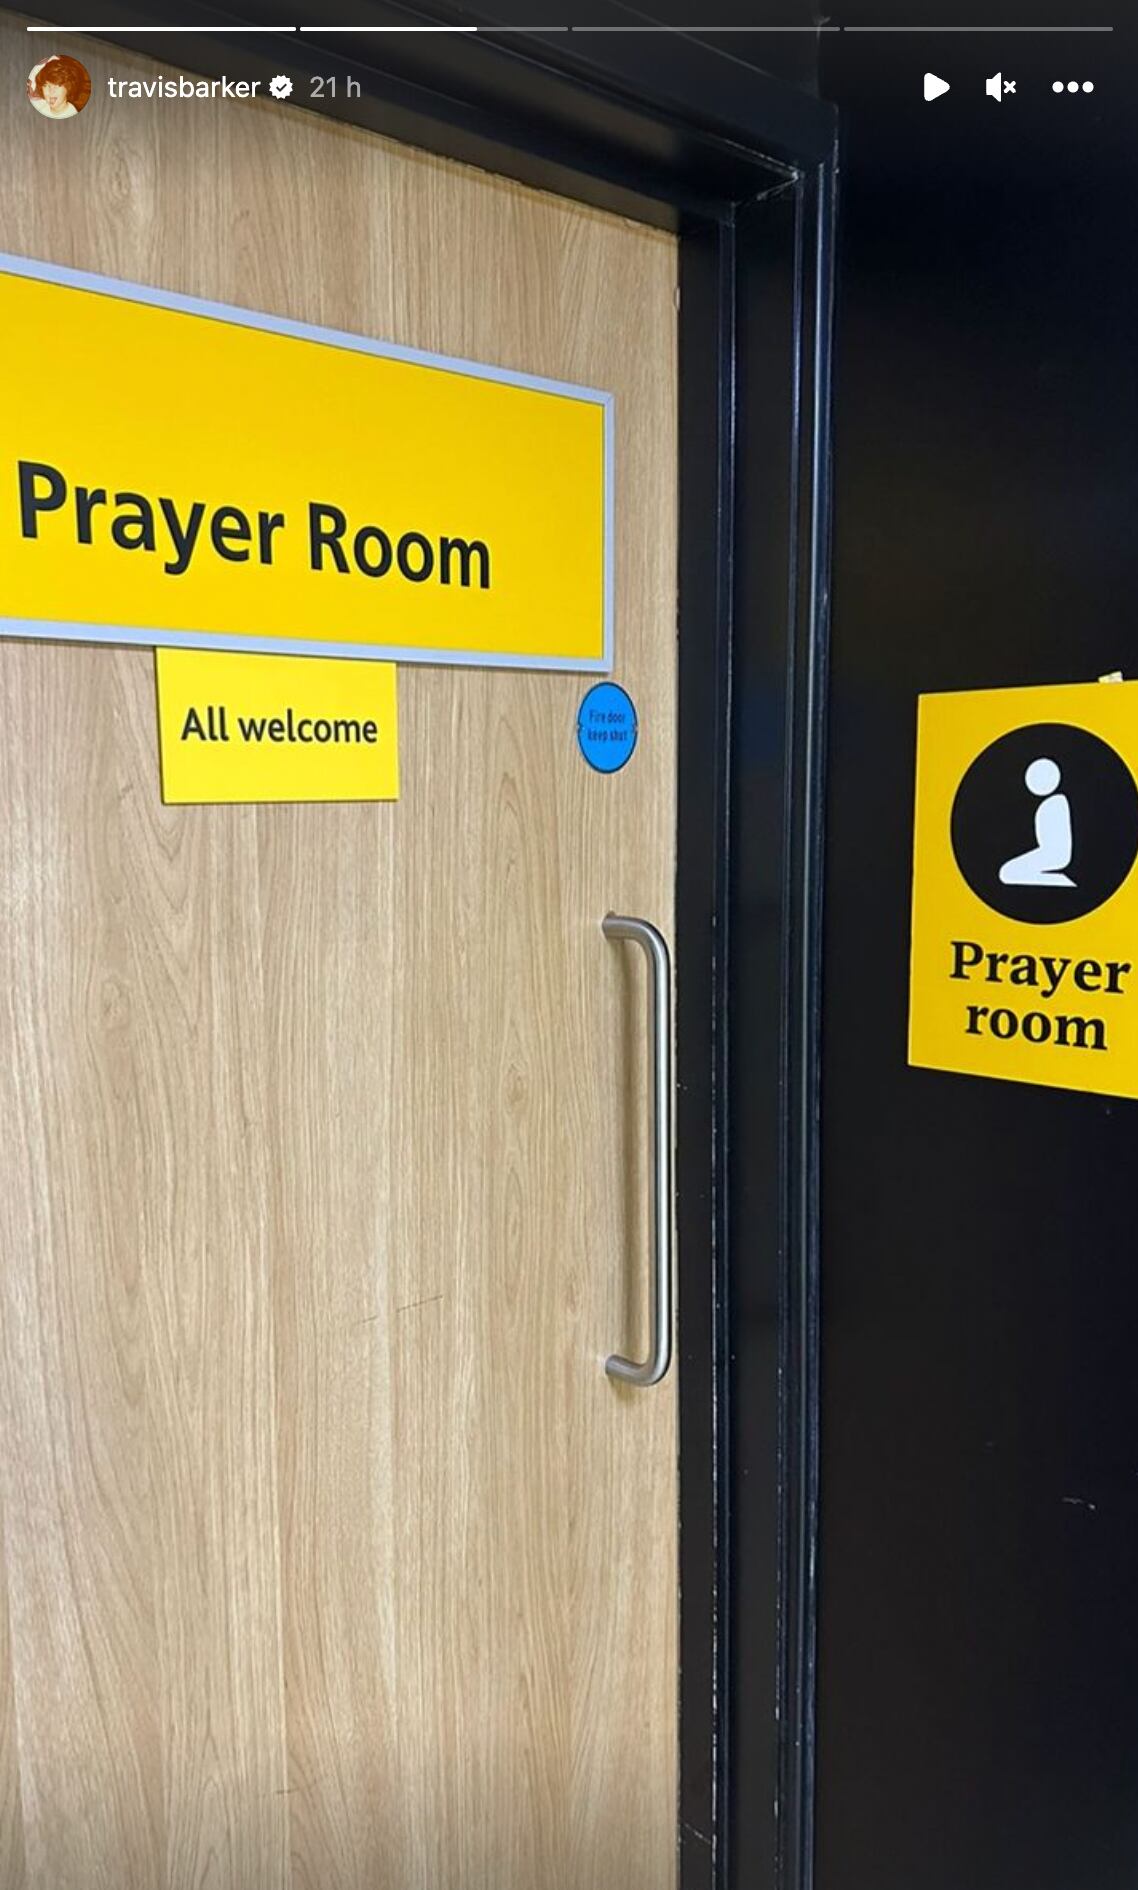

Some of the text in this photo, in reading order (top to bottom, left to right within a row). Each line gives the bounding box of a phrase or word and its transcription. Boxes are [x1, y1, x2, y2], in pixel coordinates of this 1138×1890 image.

[17, 460, 491, 590] Prayer Room
[180, 706, 379, 744] All welcome
[949, 940, 1132, 999] Prayer
[965, 1003, 1108, 1051] room
